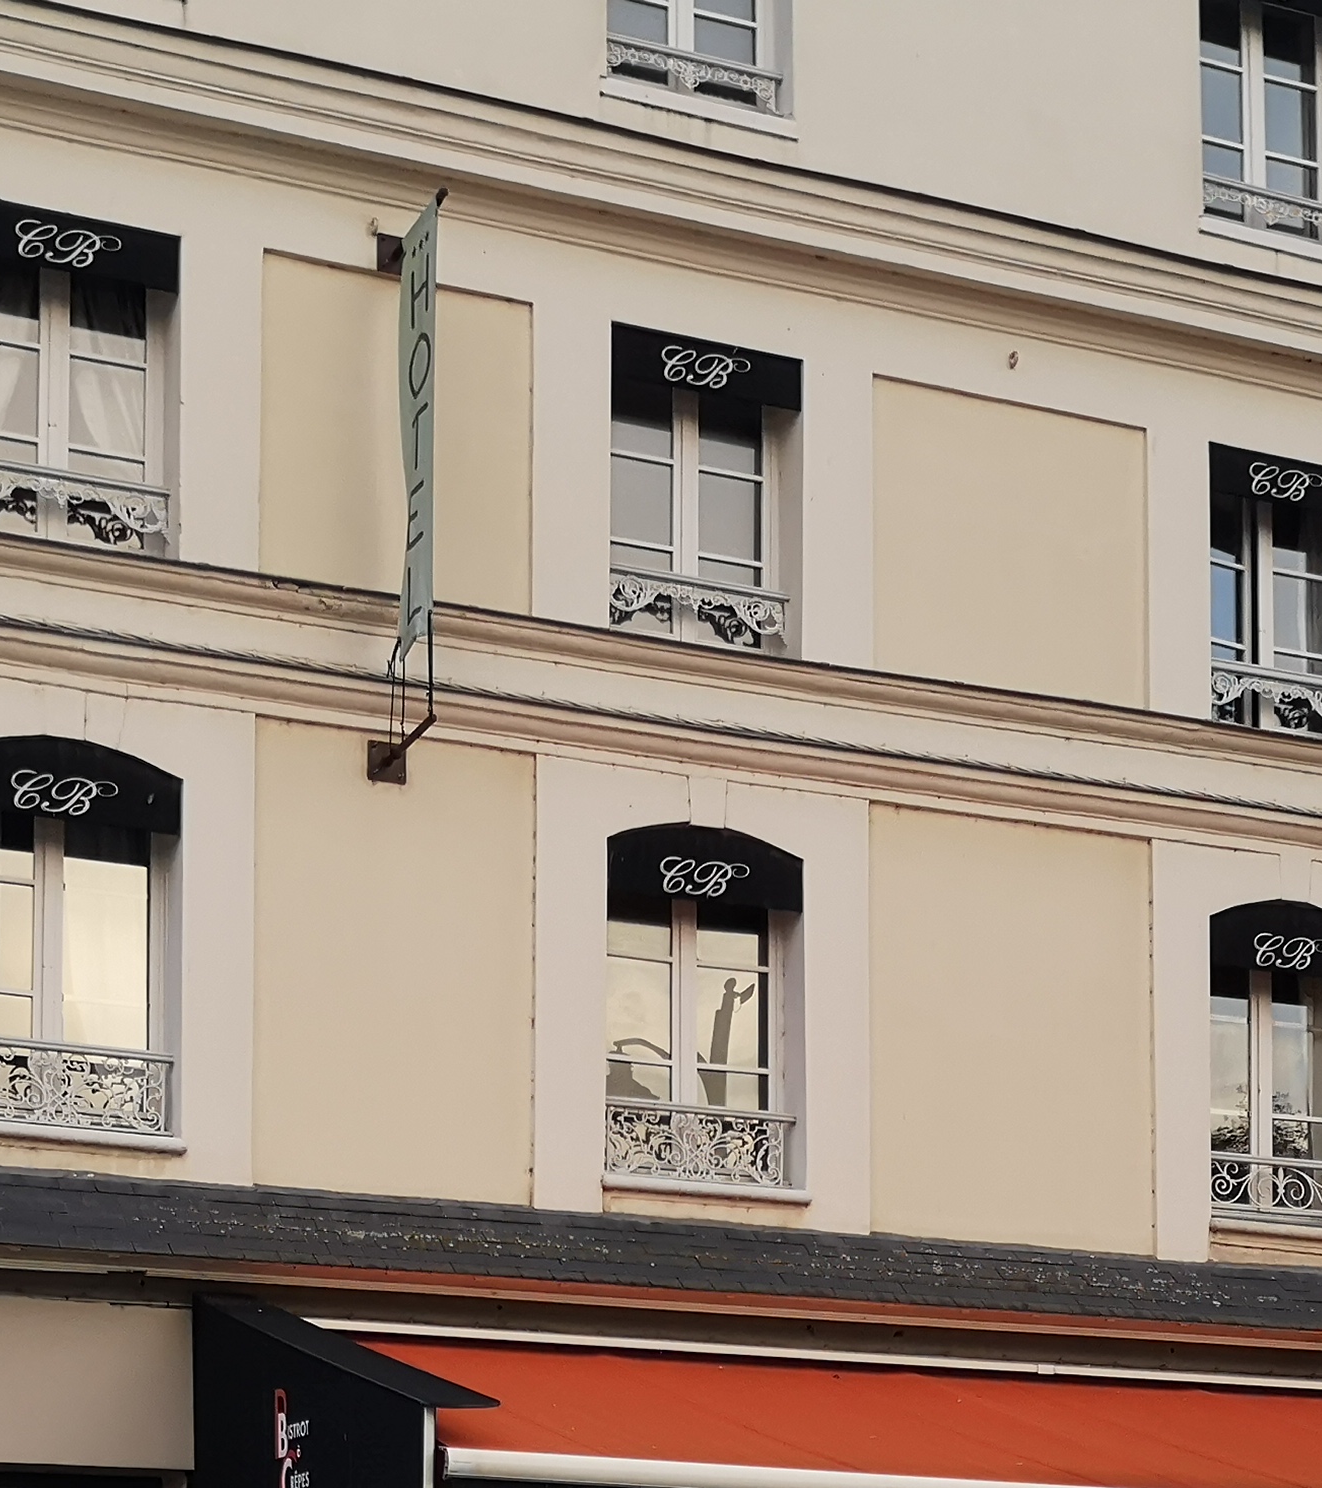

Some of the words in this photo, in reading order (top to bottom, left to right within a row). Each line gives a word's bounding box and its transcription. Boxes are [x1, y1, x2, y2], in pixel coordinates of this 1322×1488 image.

[15, 219, 121, 267] CB
[661, 349, 750, 388] CB
[406, 252, 432, 627] HOTEL
[11, 770, 118, 815] CB
[660, 856, 750, 897] CB
